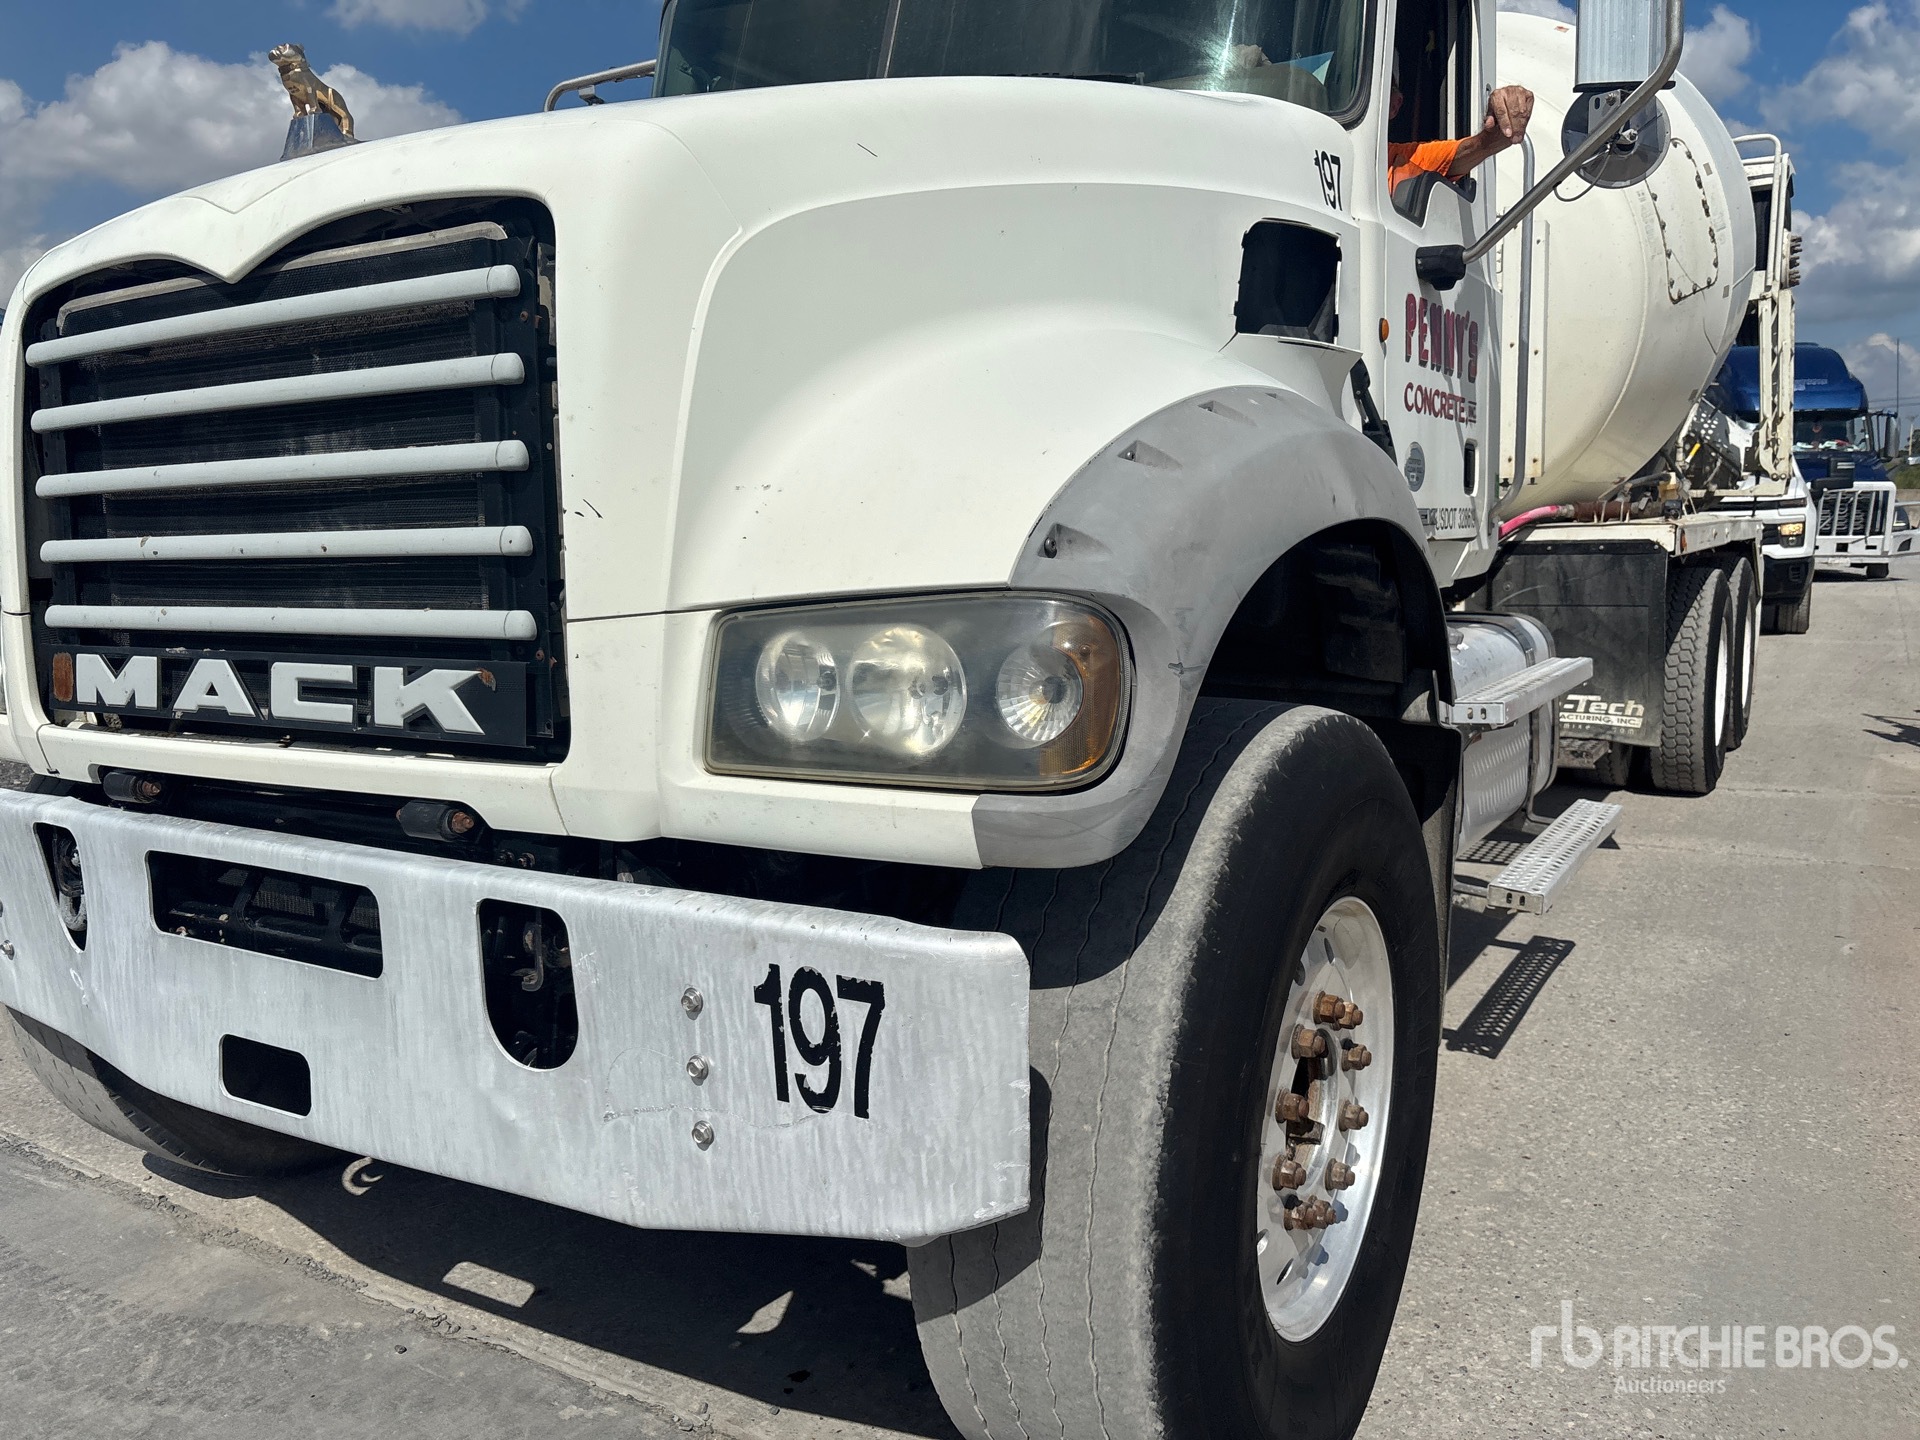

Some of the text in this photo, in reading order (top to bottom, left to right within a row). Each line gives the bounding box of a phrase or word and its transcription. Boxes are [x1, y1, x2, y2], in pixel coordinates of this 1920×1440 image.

[1313, 149, 1343, 211] 197
[1405, 293, 1479, 383] PENNY'S
[75, 653, 485, 736] MACK
[1559, 694, 1645, 716] -Tech
[753, 963, 886, 1120] 197
